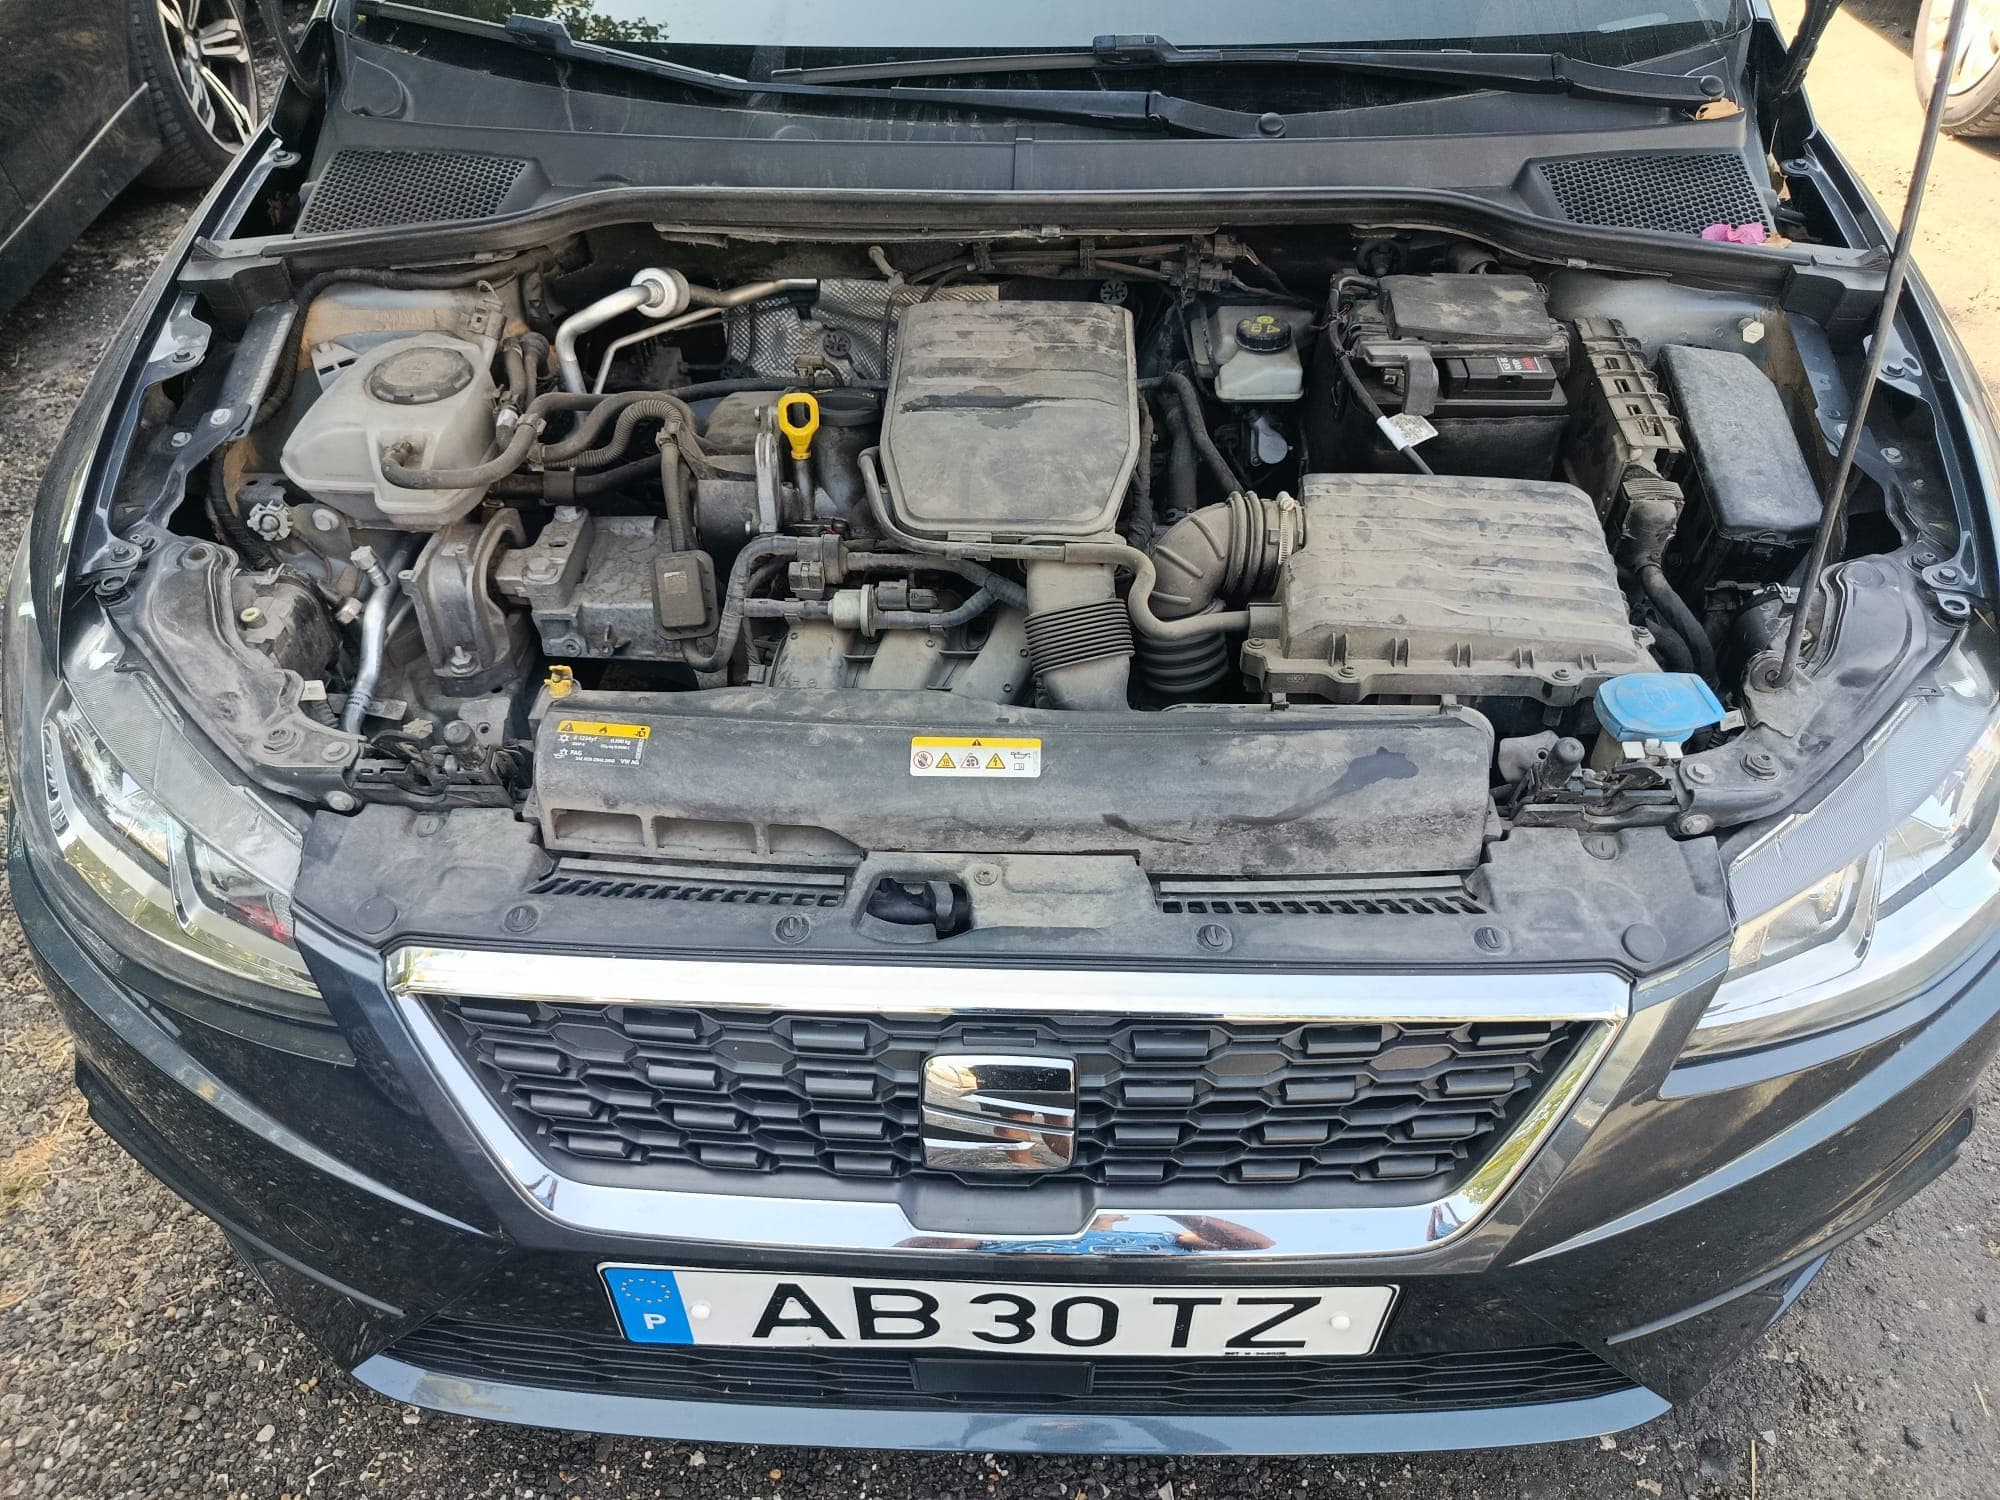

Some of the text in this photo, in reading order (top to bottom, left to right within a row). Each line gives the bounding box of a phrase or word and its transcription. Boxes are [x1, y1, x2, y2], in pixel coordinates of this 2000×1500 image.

[644, 1313, 667, 1330] P
[752, 1284, 1322, 1349] AB 30 TZ
